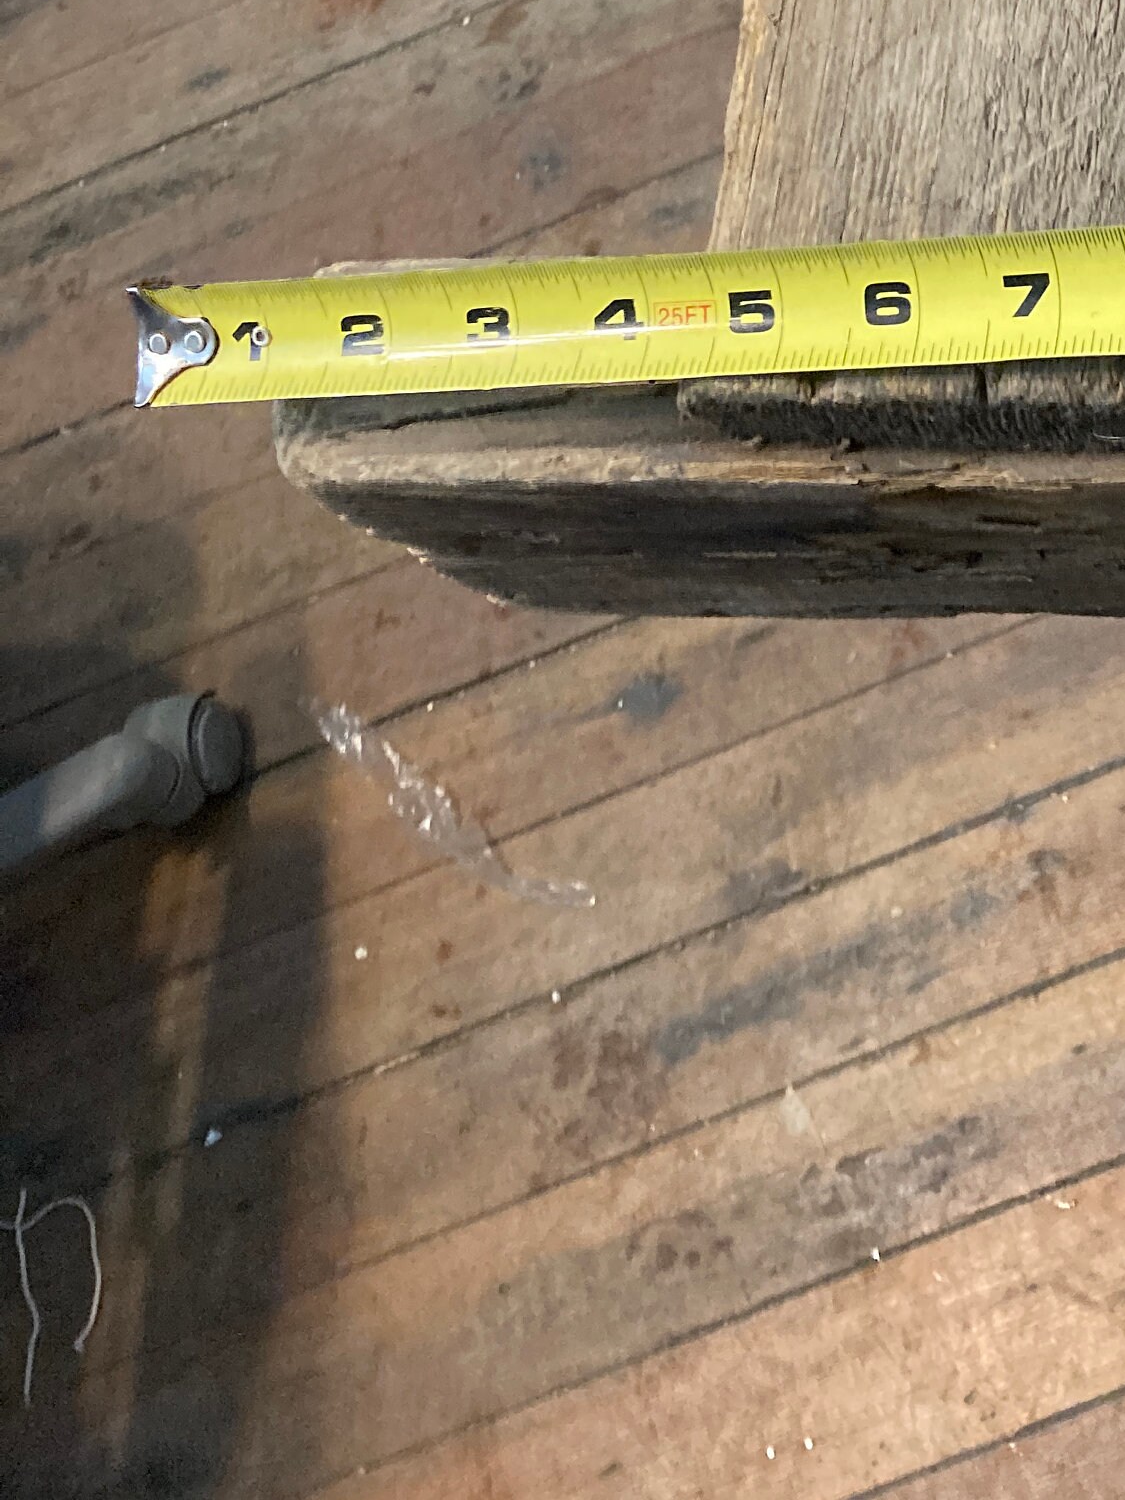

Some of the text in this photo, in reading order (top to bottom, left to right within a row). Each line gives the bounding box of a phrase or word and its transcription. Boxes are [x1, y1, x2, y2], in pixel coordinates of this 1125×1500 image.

[232, 321, 271, 362] 1
[340, 314, 384, 356] 2
[465, 306, 510, 342] 3
[594, 298, 644, 341] 4
[656, 302, 712, 327] 25FT
[728, 289, 774, 334] 5
[864, 282, 912, 326] 6
[1002, 273, 1051, 317] 7
